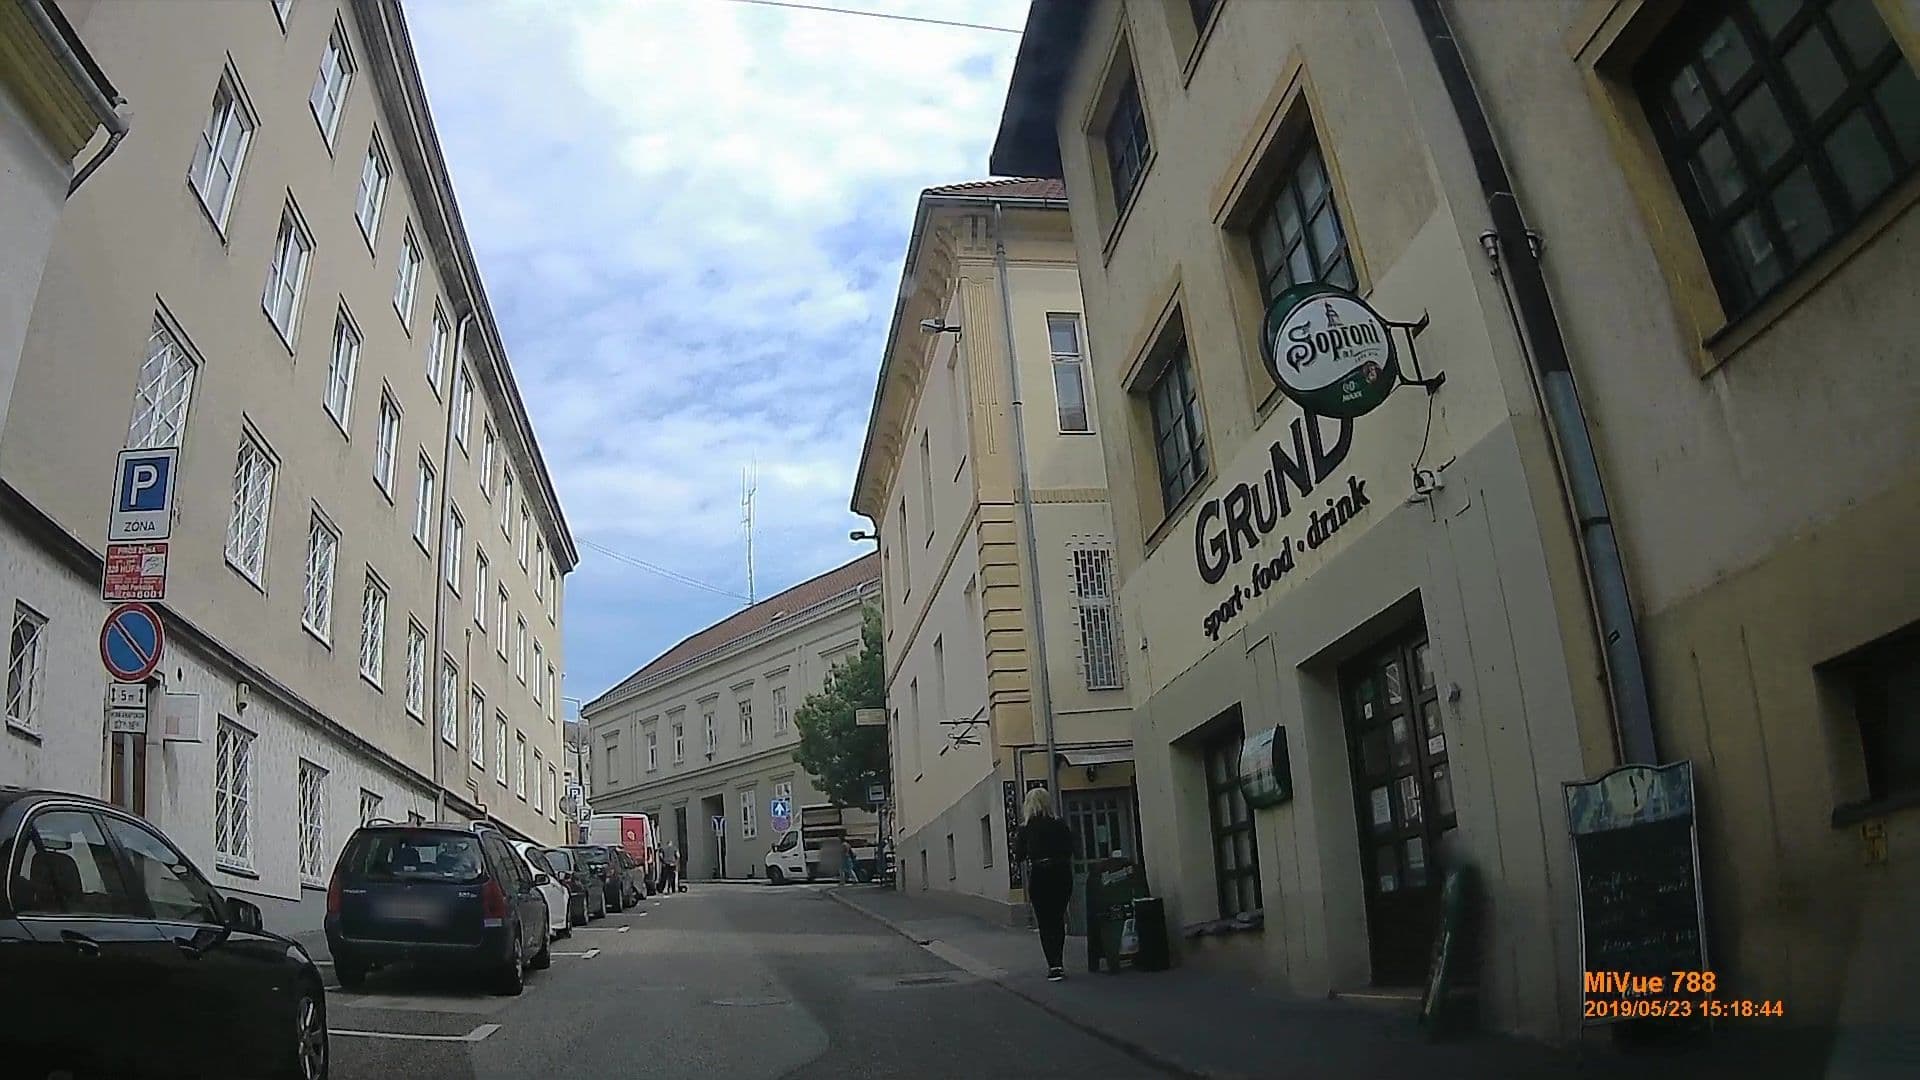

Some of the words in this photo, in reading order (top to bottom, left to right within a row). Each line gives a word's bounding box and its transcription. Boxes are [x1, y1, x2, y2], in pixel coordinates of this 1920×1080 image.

[1287, 320, 1380, 374] Soproni
[129, 464, 158, 507] P
[1196, 410, 1353, 585] GRUND
[123, 520, 156, 532] ZÓNA
[1204, 585, 1243, 641] sport
[1252, 537, 1295, 597] food
[1307, 476, 1371, 550] drink
[120, 689, 127, 701] 5
